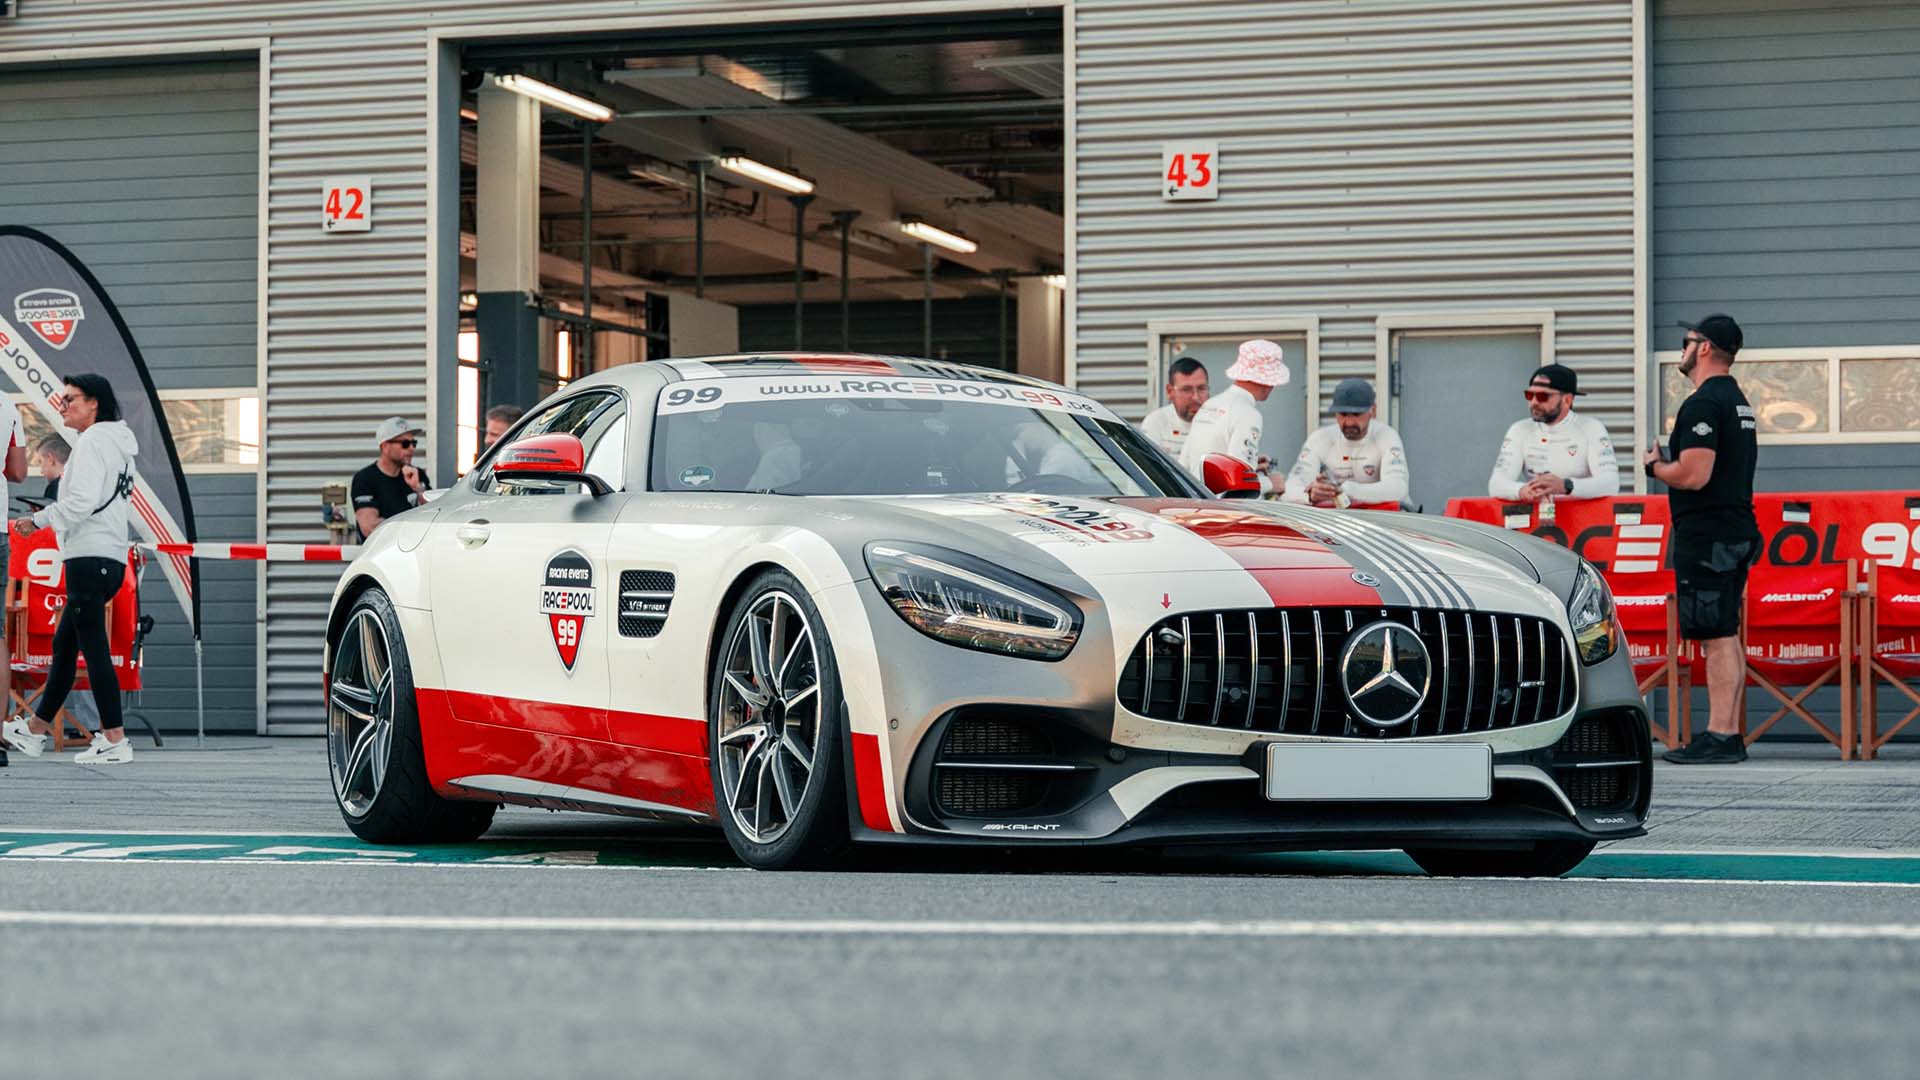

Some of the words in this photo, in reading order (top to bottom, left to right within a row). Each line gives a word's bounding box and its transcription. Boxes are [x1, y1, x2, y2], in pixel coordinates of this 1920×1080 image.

[1167, 153, 1211, 187] 43
[325, 187, 364, 220] 42
[666, 386, 723, 407] 99
[543, 591, 593, 611] RACEPOOL
[1760, 592, 1827, 603] McLaren
[558, 619, 577, 646] 99
[1000, 823, 1061, 831] KAHNT
